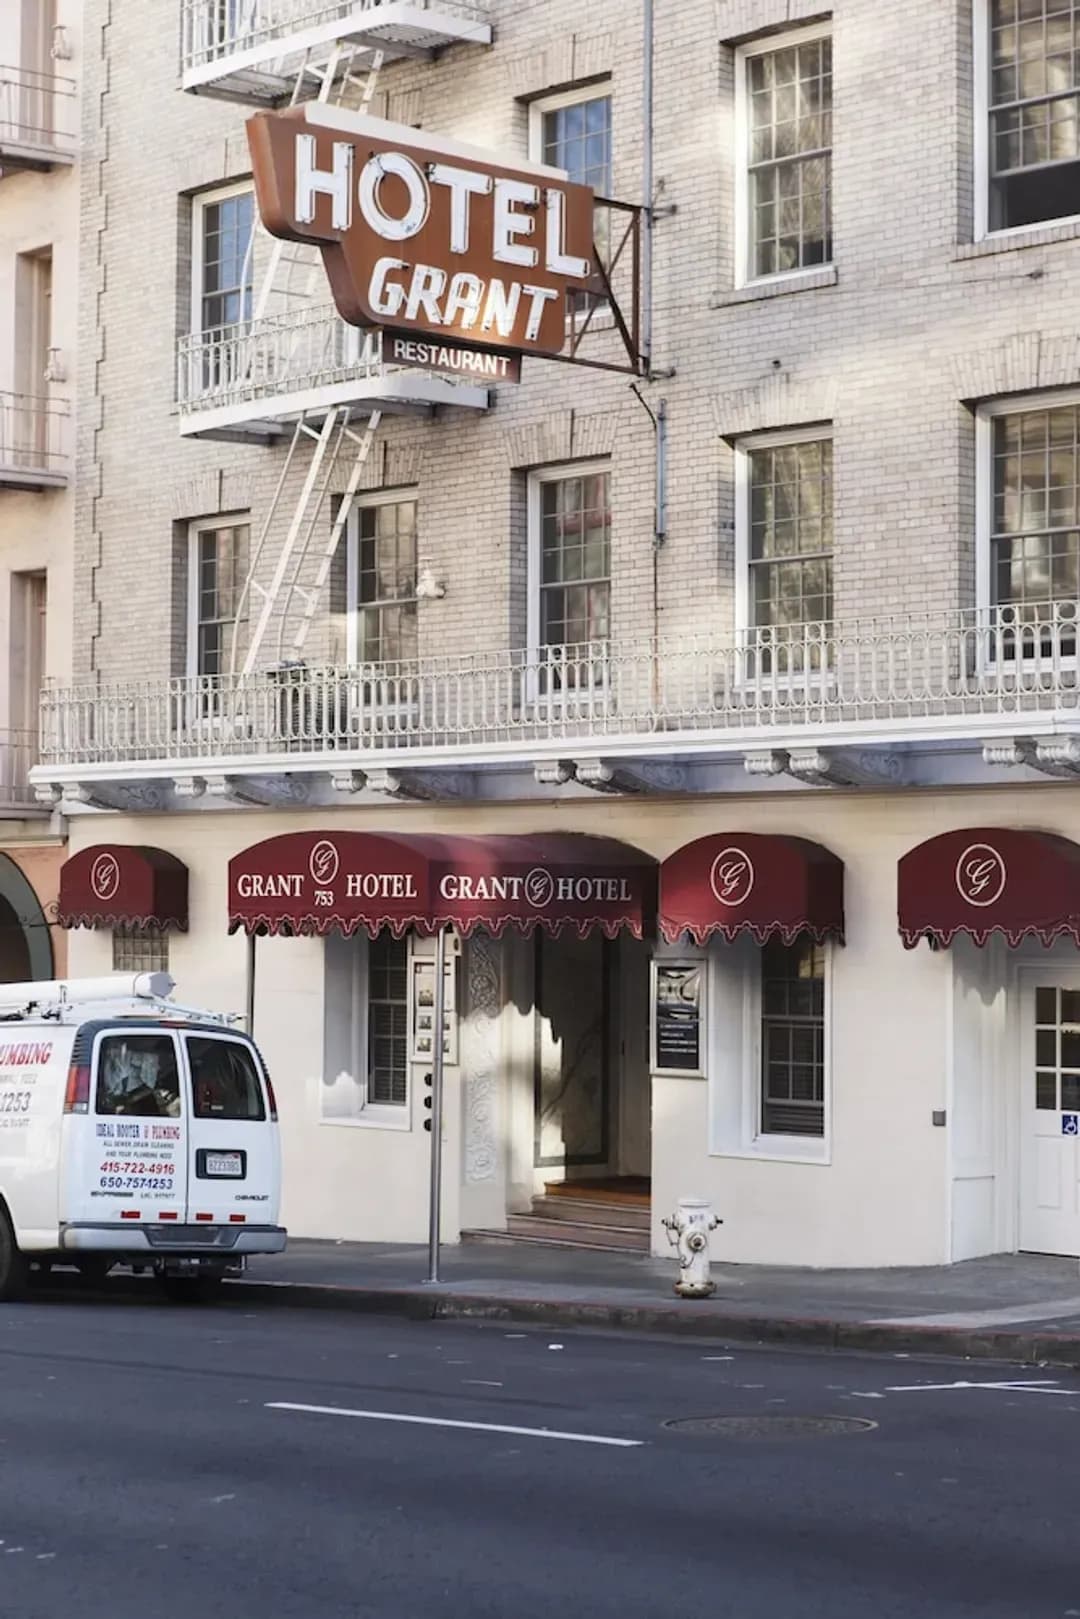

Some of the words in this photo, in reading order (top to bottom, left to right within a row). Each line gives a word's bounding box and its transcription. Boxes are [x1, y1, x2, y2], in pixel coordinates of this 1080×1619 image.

[295, 134, 591, 279] HOTEL
[368, 257, 559, 341] GRANT
[394, 339, 511, 376] RESTAURANT
[237, 874, 304, 898] GRANT
[346, 873, 417, 898] HOTEL
[440, 875, 523, 899] GRANT
[557, 877, 631, 901] HOTEL
[314, 891, 334, 906] 753
[100, 1162, 175, 1175] 415-722-4916
[100, 1177, 173, 1190] 650-757-1253
